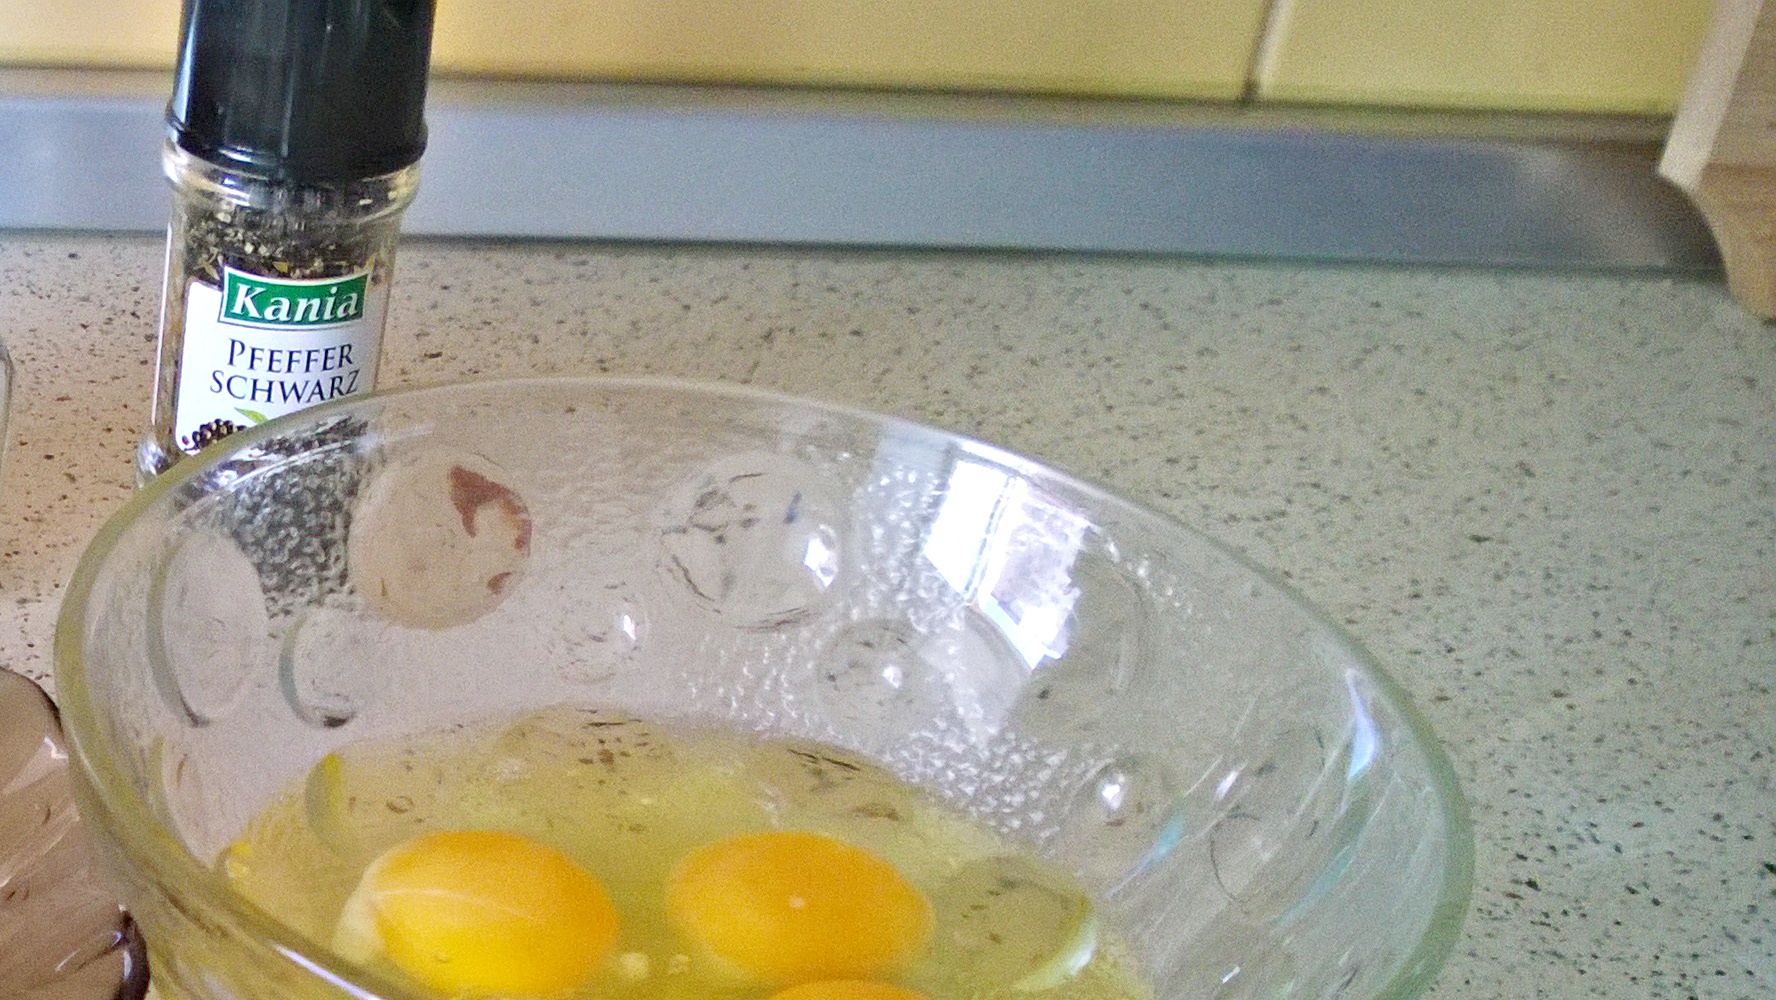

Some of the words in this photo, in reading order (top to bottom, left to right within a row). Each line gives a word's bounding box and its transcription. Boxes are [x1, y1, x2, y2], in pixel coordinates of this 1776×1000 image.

[232, 282, 360, 324] Kania
[227, 337, 354, 374] PFEFFER
[209, 369, 361, 404] SCHWARZ
